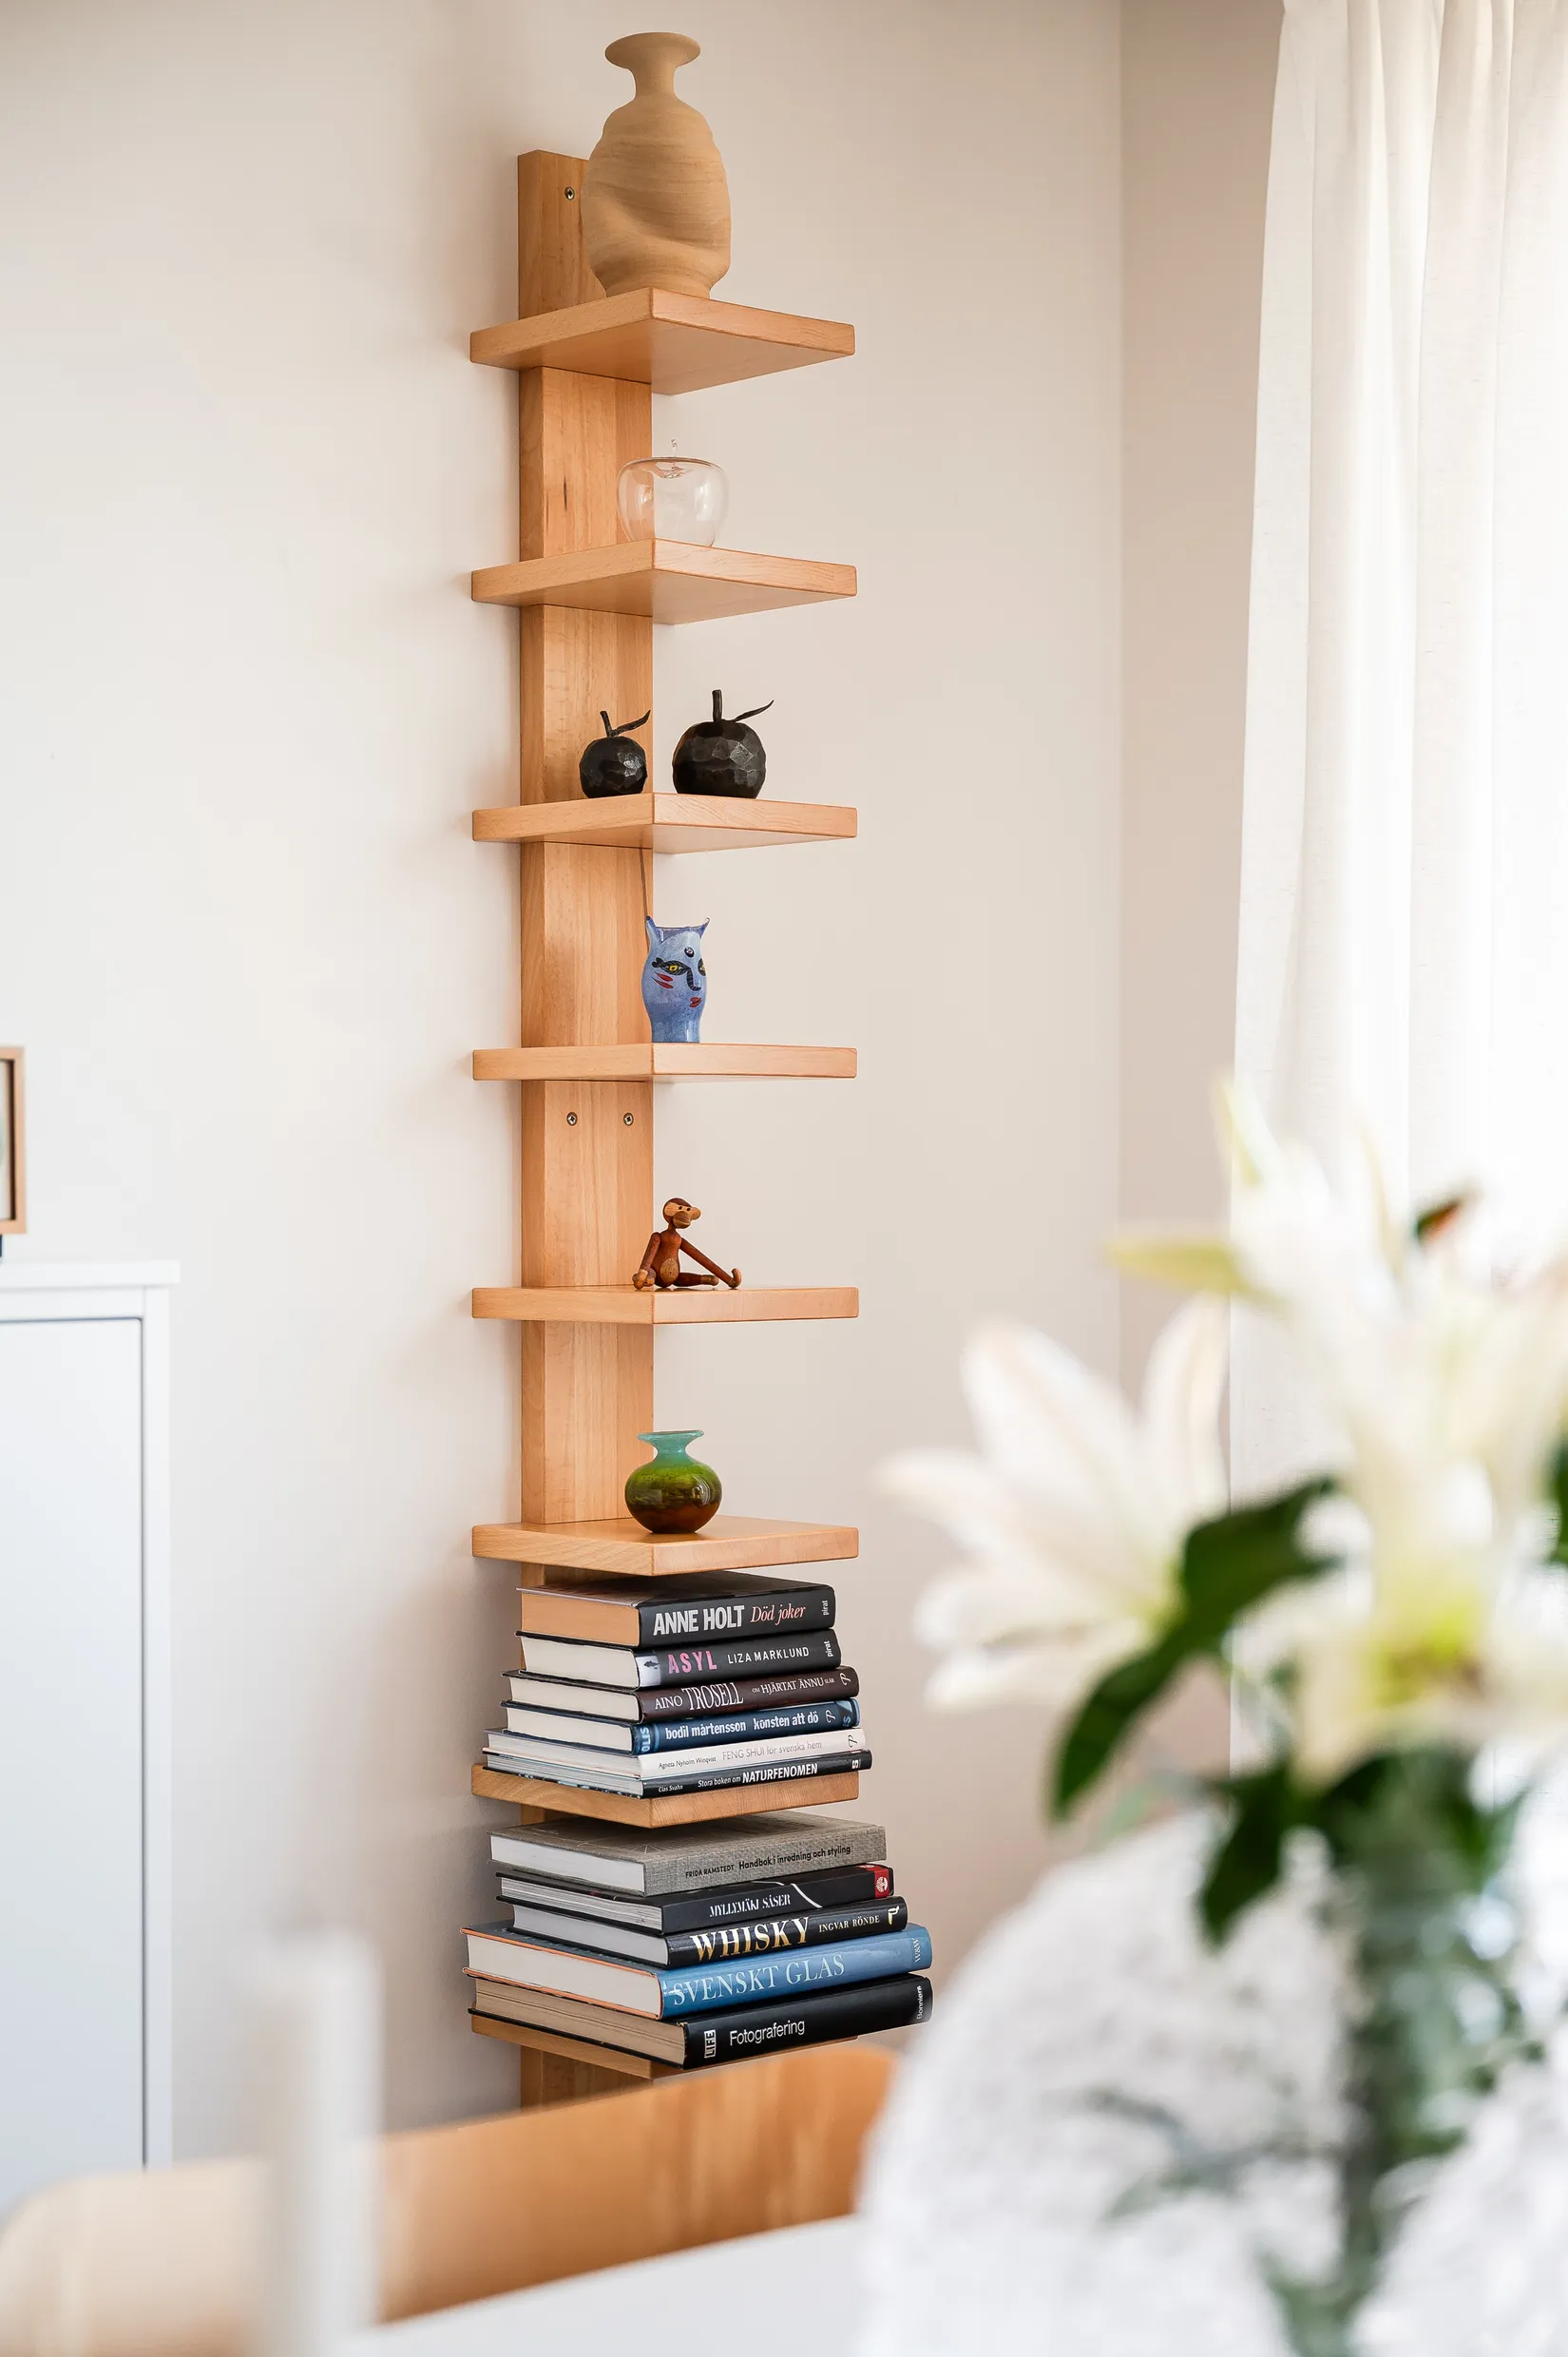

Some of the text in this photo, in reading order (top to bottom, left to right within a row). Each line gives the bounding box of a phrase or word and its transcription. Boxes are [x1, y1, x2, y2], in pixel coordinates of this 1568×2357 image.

[654, 1605, 745, 1636] ANNE HOLT
[750, 1602, 806, 1626] Död joker
[727, 1646, 810, 1664] LIZA MARKLUND
[824, 1640, 833, 1658] pirat
[668, 1650, 717, 1675] ASYL
[655, 1682, 744, 1711] AINO TROSELL
[760, 1680, 796, 1695] HJÄRTAT
[798, 1677, 825, 1689] ÄNNU
[665, 1721, 746, 1740] bodil mårtensson
[754, 1711, 819, 1730] konsten att dö
[722, 1741, 822, 1760] FENG SHUI för svenska hem
[676, 1758, 695, 1768] Nyholm
[698, 1779, 713, 1788] Stora
[714, 1776, 731, 1786] boken
[742, 1763, 818, 1783] NATURFENOMEN
[738, 1858, 773, 1870] Handbok
[777, 1851, 812, 1864] inredning
[813, 1849, 826, 1857] och
[827, 1846, 851, 1857] styling
[685, 1865, 734, 1878] FRIDA RAMSTEDT
[709, 1893, 792, 1918] MYLLYMÄKI SÅSER
[818, 1915, 880, 1933] INGVAR RÖNDE
[689, 1916, 810, 1962] WHISKY
[671, 1954, 845, 2006] SVENSKT GLAS
[704, 2029, 716, 2059] LIFE
[730, 2020, 805, 2046] Fotografering
